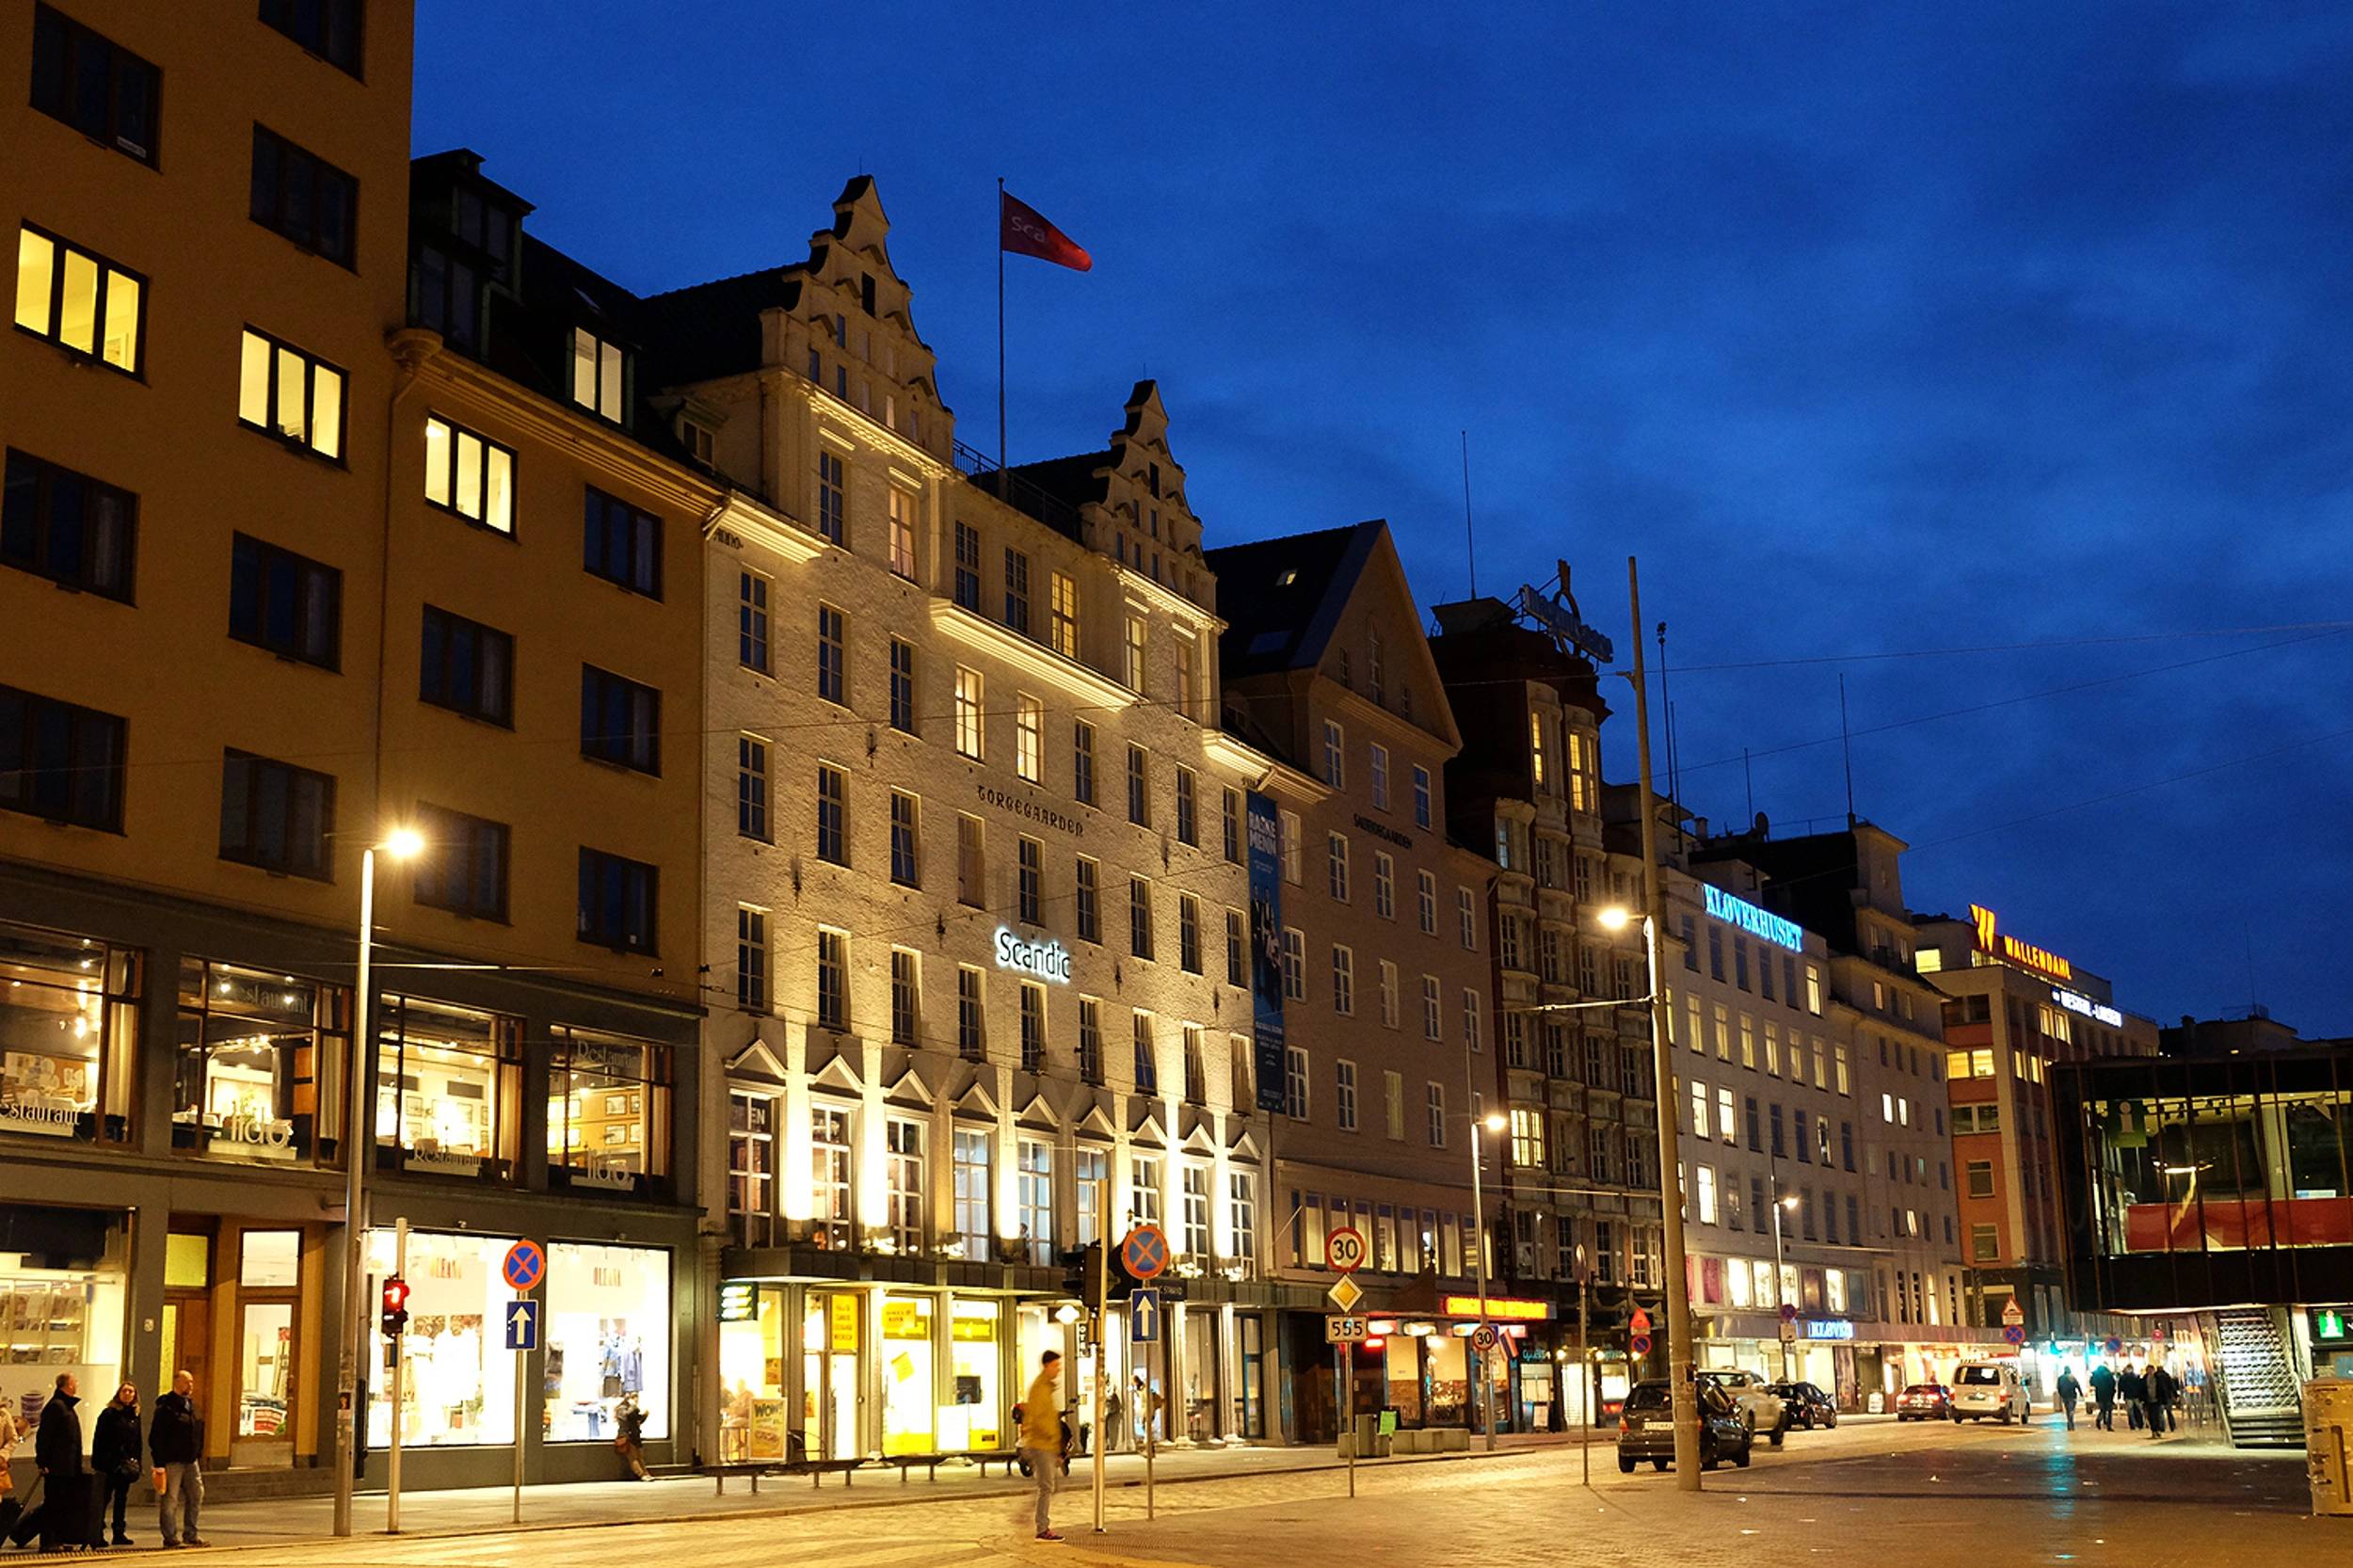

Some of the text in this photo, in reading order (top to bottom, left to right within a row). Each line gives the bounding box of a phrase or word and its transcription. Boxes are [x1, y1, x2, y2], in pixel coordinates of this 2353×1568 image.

[1702, 883, 1802, 952] KLØVERHUSET
[998, 930, 1070, 980] Scandic
[2004, 935, 2072, 981] WALLENDAHL
[1333, 1238, 1358, 1260] 30
[1332, 1321, 1363, 1336] 555
[1477, 1332, 1493, 1346] 30
